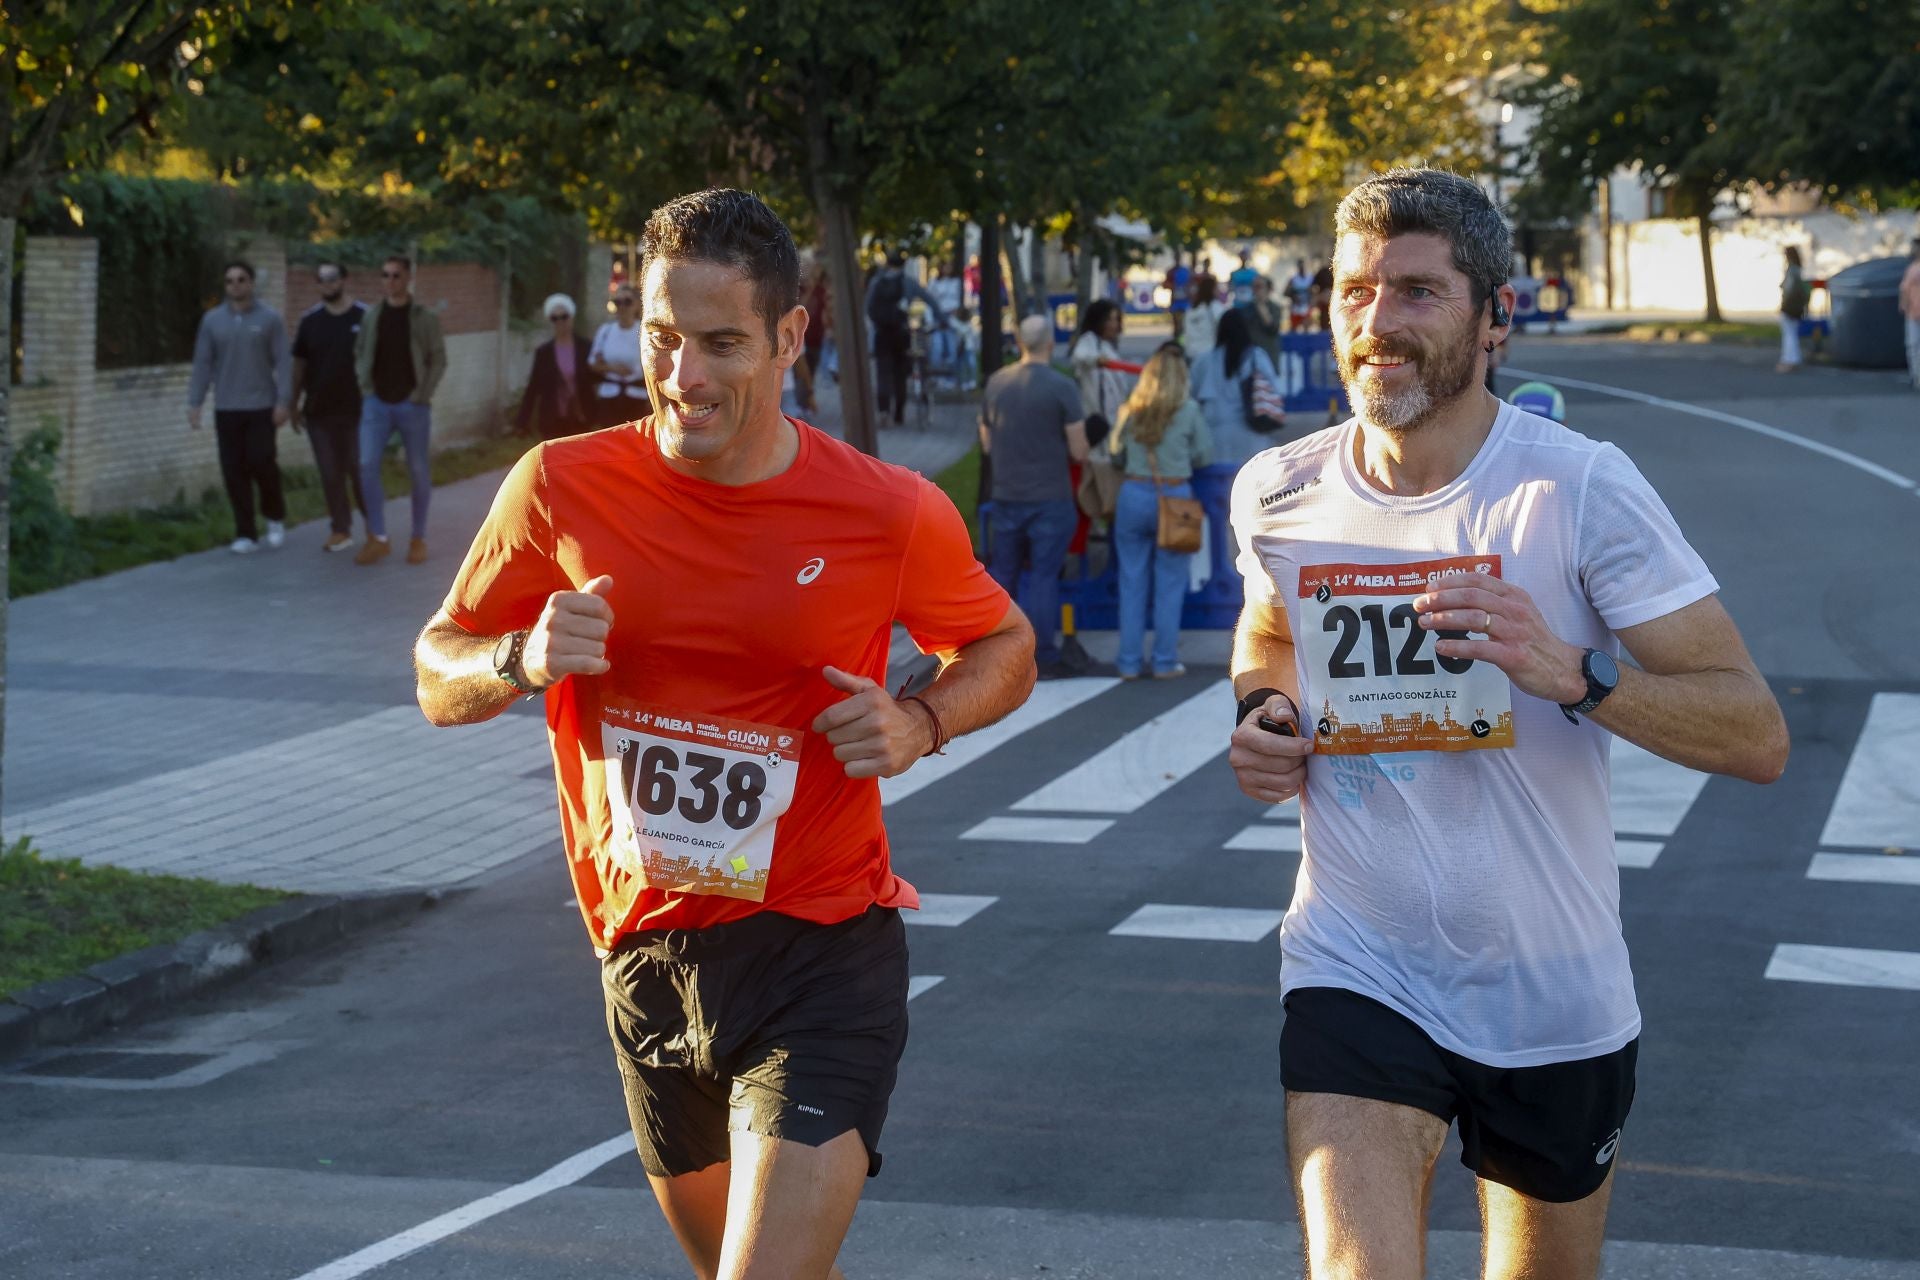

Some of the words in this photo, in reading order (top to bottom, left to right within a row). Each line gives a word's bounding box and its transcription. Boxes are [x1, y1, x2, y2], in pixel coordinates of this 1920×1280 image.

[1354, 575, 1395, 587] MBA
[1399, 578, 1426, 587] maratón
[1348, 692, 1402, 702] SANTIAGO
[1404, 688, 1457, 699] GONZÁLEZ
[653, 716, 694, 733] MBA
[697, 723, 719, 732] media
[696, 729, 726, 740] maratón
[727, 729, 770, 747] GIJÓN
[1327, 755, 1416, 781] RUNNNG
[621, 738, 767, 830] 1638
[633, 825, 690, 844] LEJANDRO
[691, 837, 726, 850] GARCÍA
[797, 1104, 824, 1116] KIPRUN
